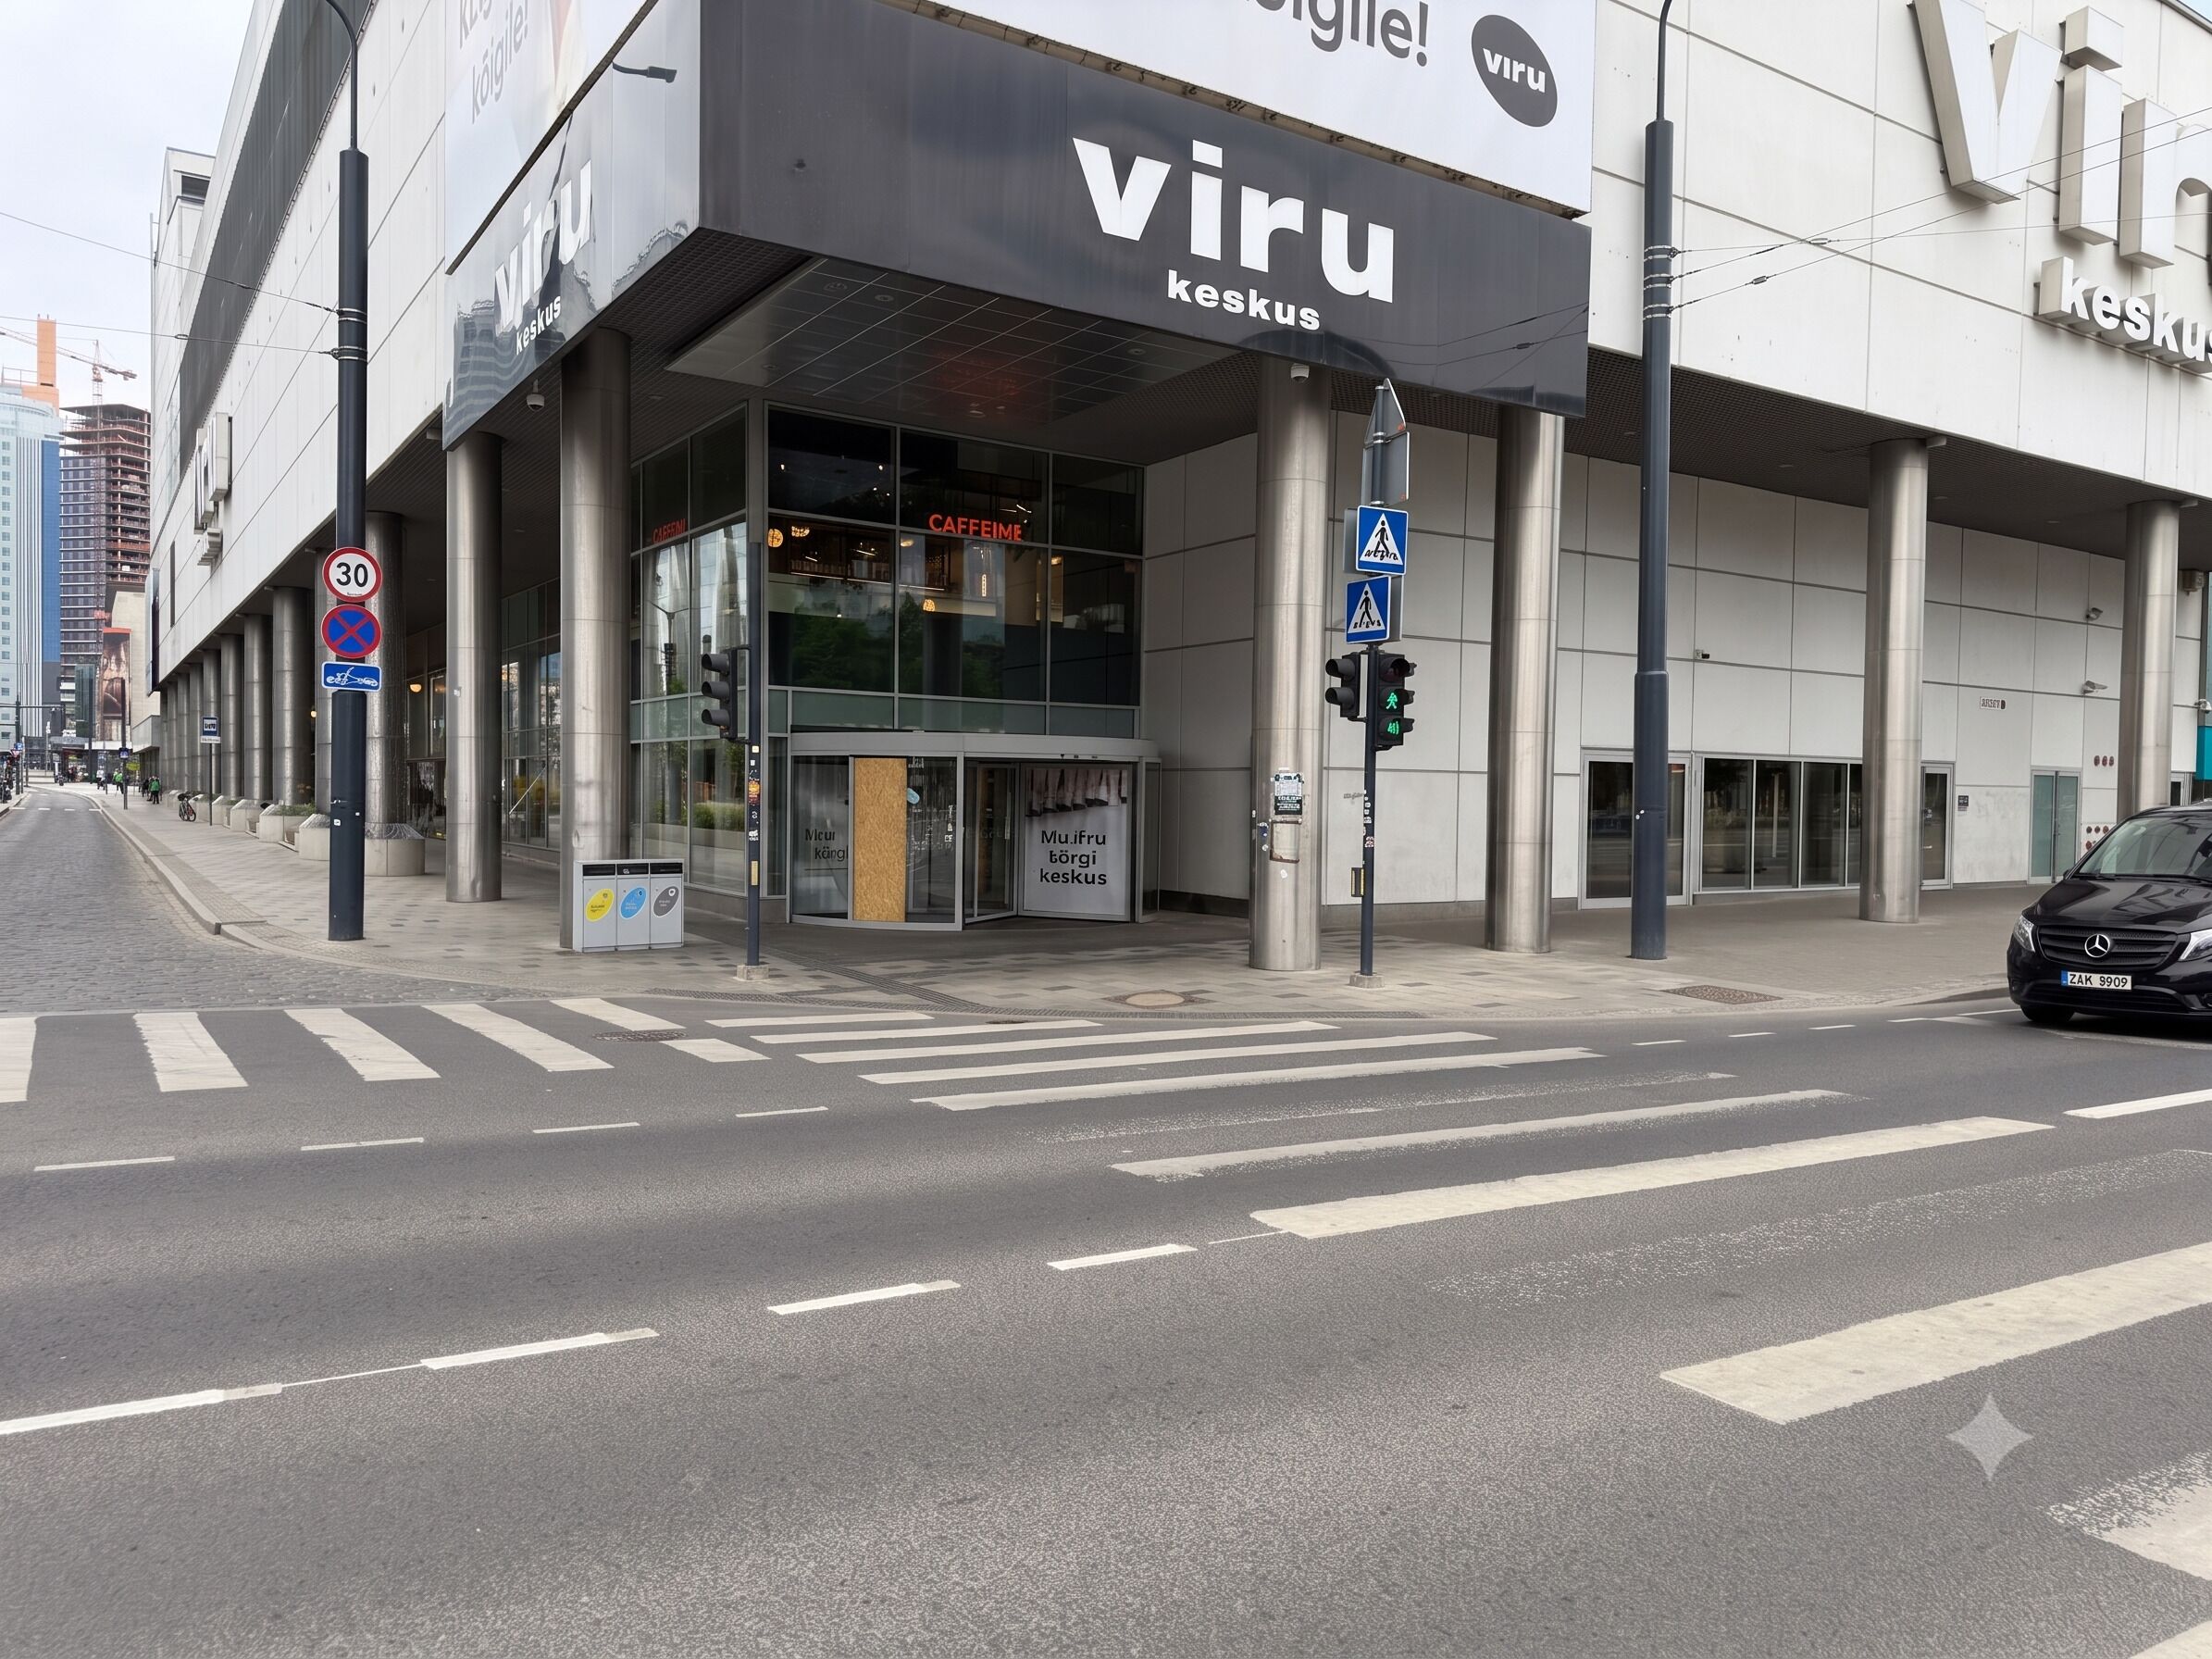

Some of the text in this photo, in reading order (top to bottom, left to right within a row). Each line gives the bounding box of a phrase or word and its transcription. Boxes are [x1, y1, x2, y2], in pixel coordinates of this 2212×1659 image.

[1482, 47, 1546, 94] viru
[1073, 137, 1395, 304] viru
[516, 295, 561, 356] keskus
[1168, 269, 1321, 331] keskus
[2040, 256, 2212, 363] kesku
[336, 562, 368, 588] 30
[1039, 867, 1107, 885] keskus
[2069, 973, 2094, 986] ZAK
